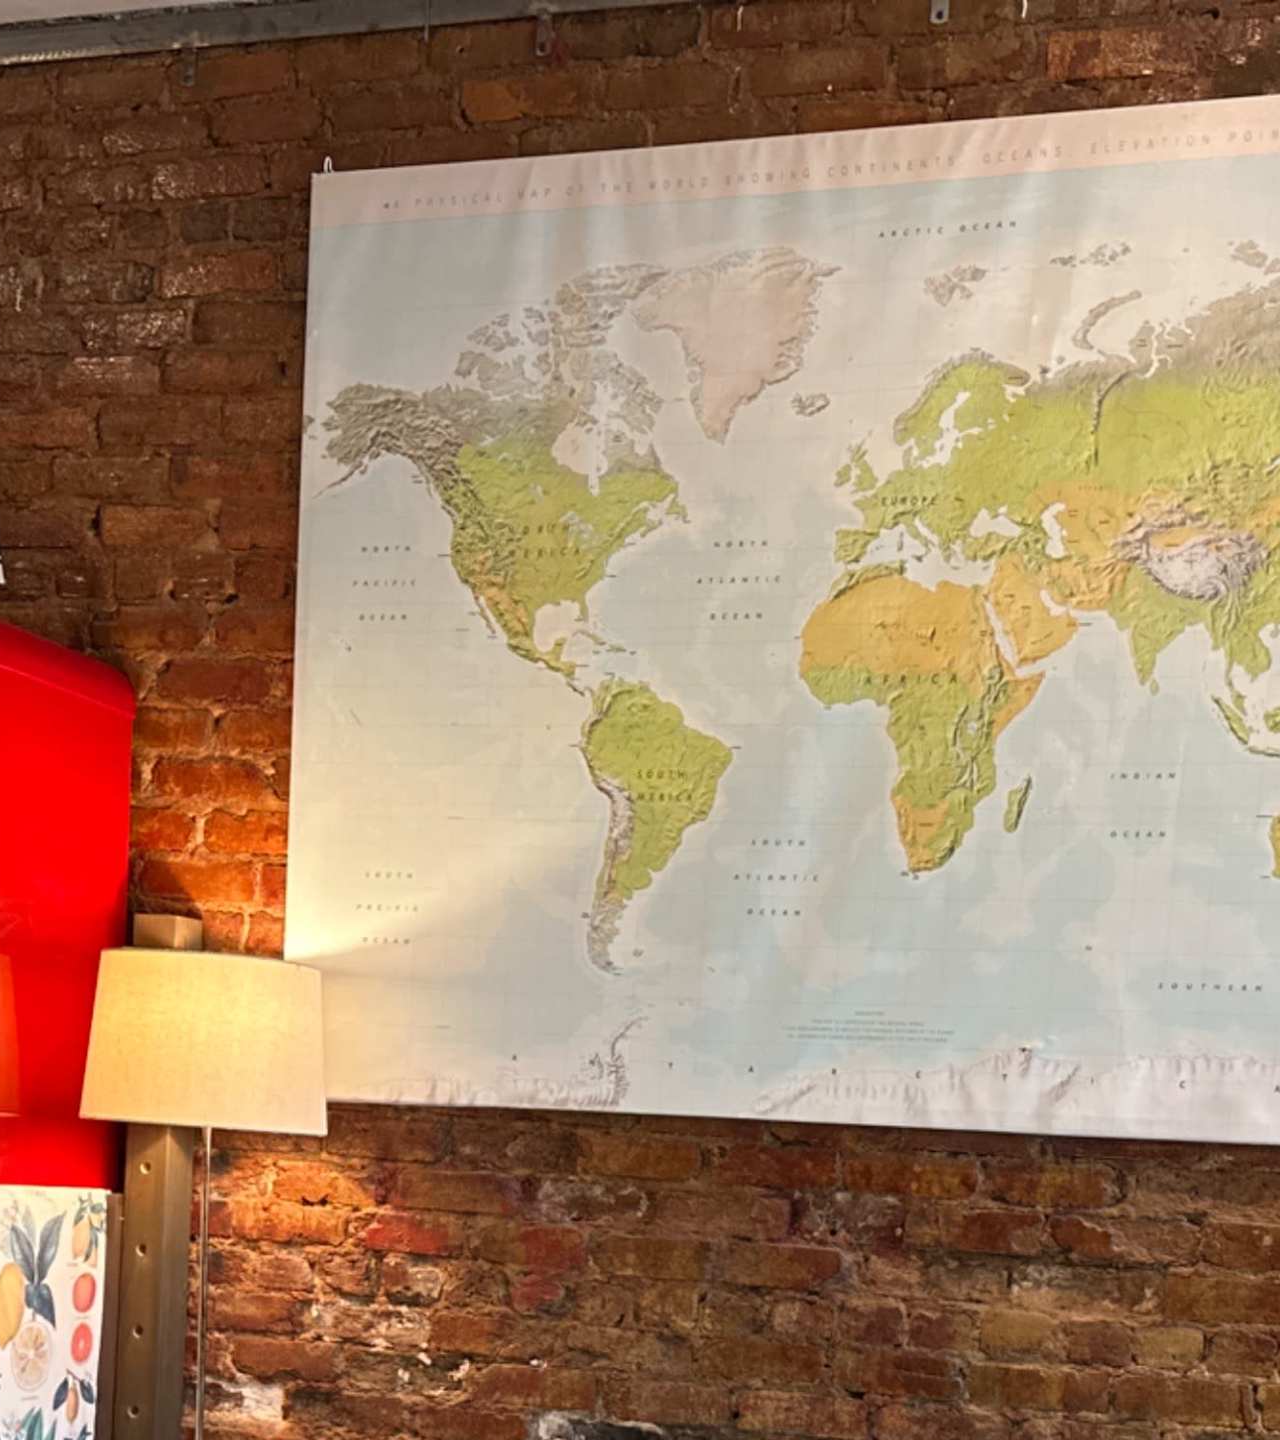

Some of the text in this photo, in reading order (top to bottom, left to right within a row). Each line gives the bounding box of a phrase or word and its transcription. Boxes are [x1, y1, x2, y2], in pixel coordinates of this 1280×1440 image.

[600, 181, 634, 195] THE
[647, 175, 710, 191] WORLD
[724, 168, 811, 187] SHOWING
[959, 219, 1019, 234] OCEAN
[864, 673, 959, 686] AFRICA
[1109, 772, 1179, 781] INDIAN
[1109, 829, 1168, 839] OCEAN
